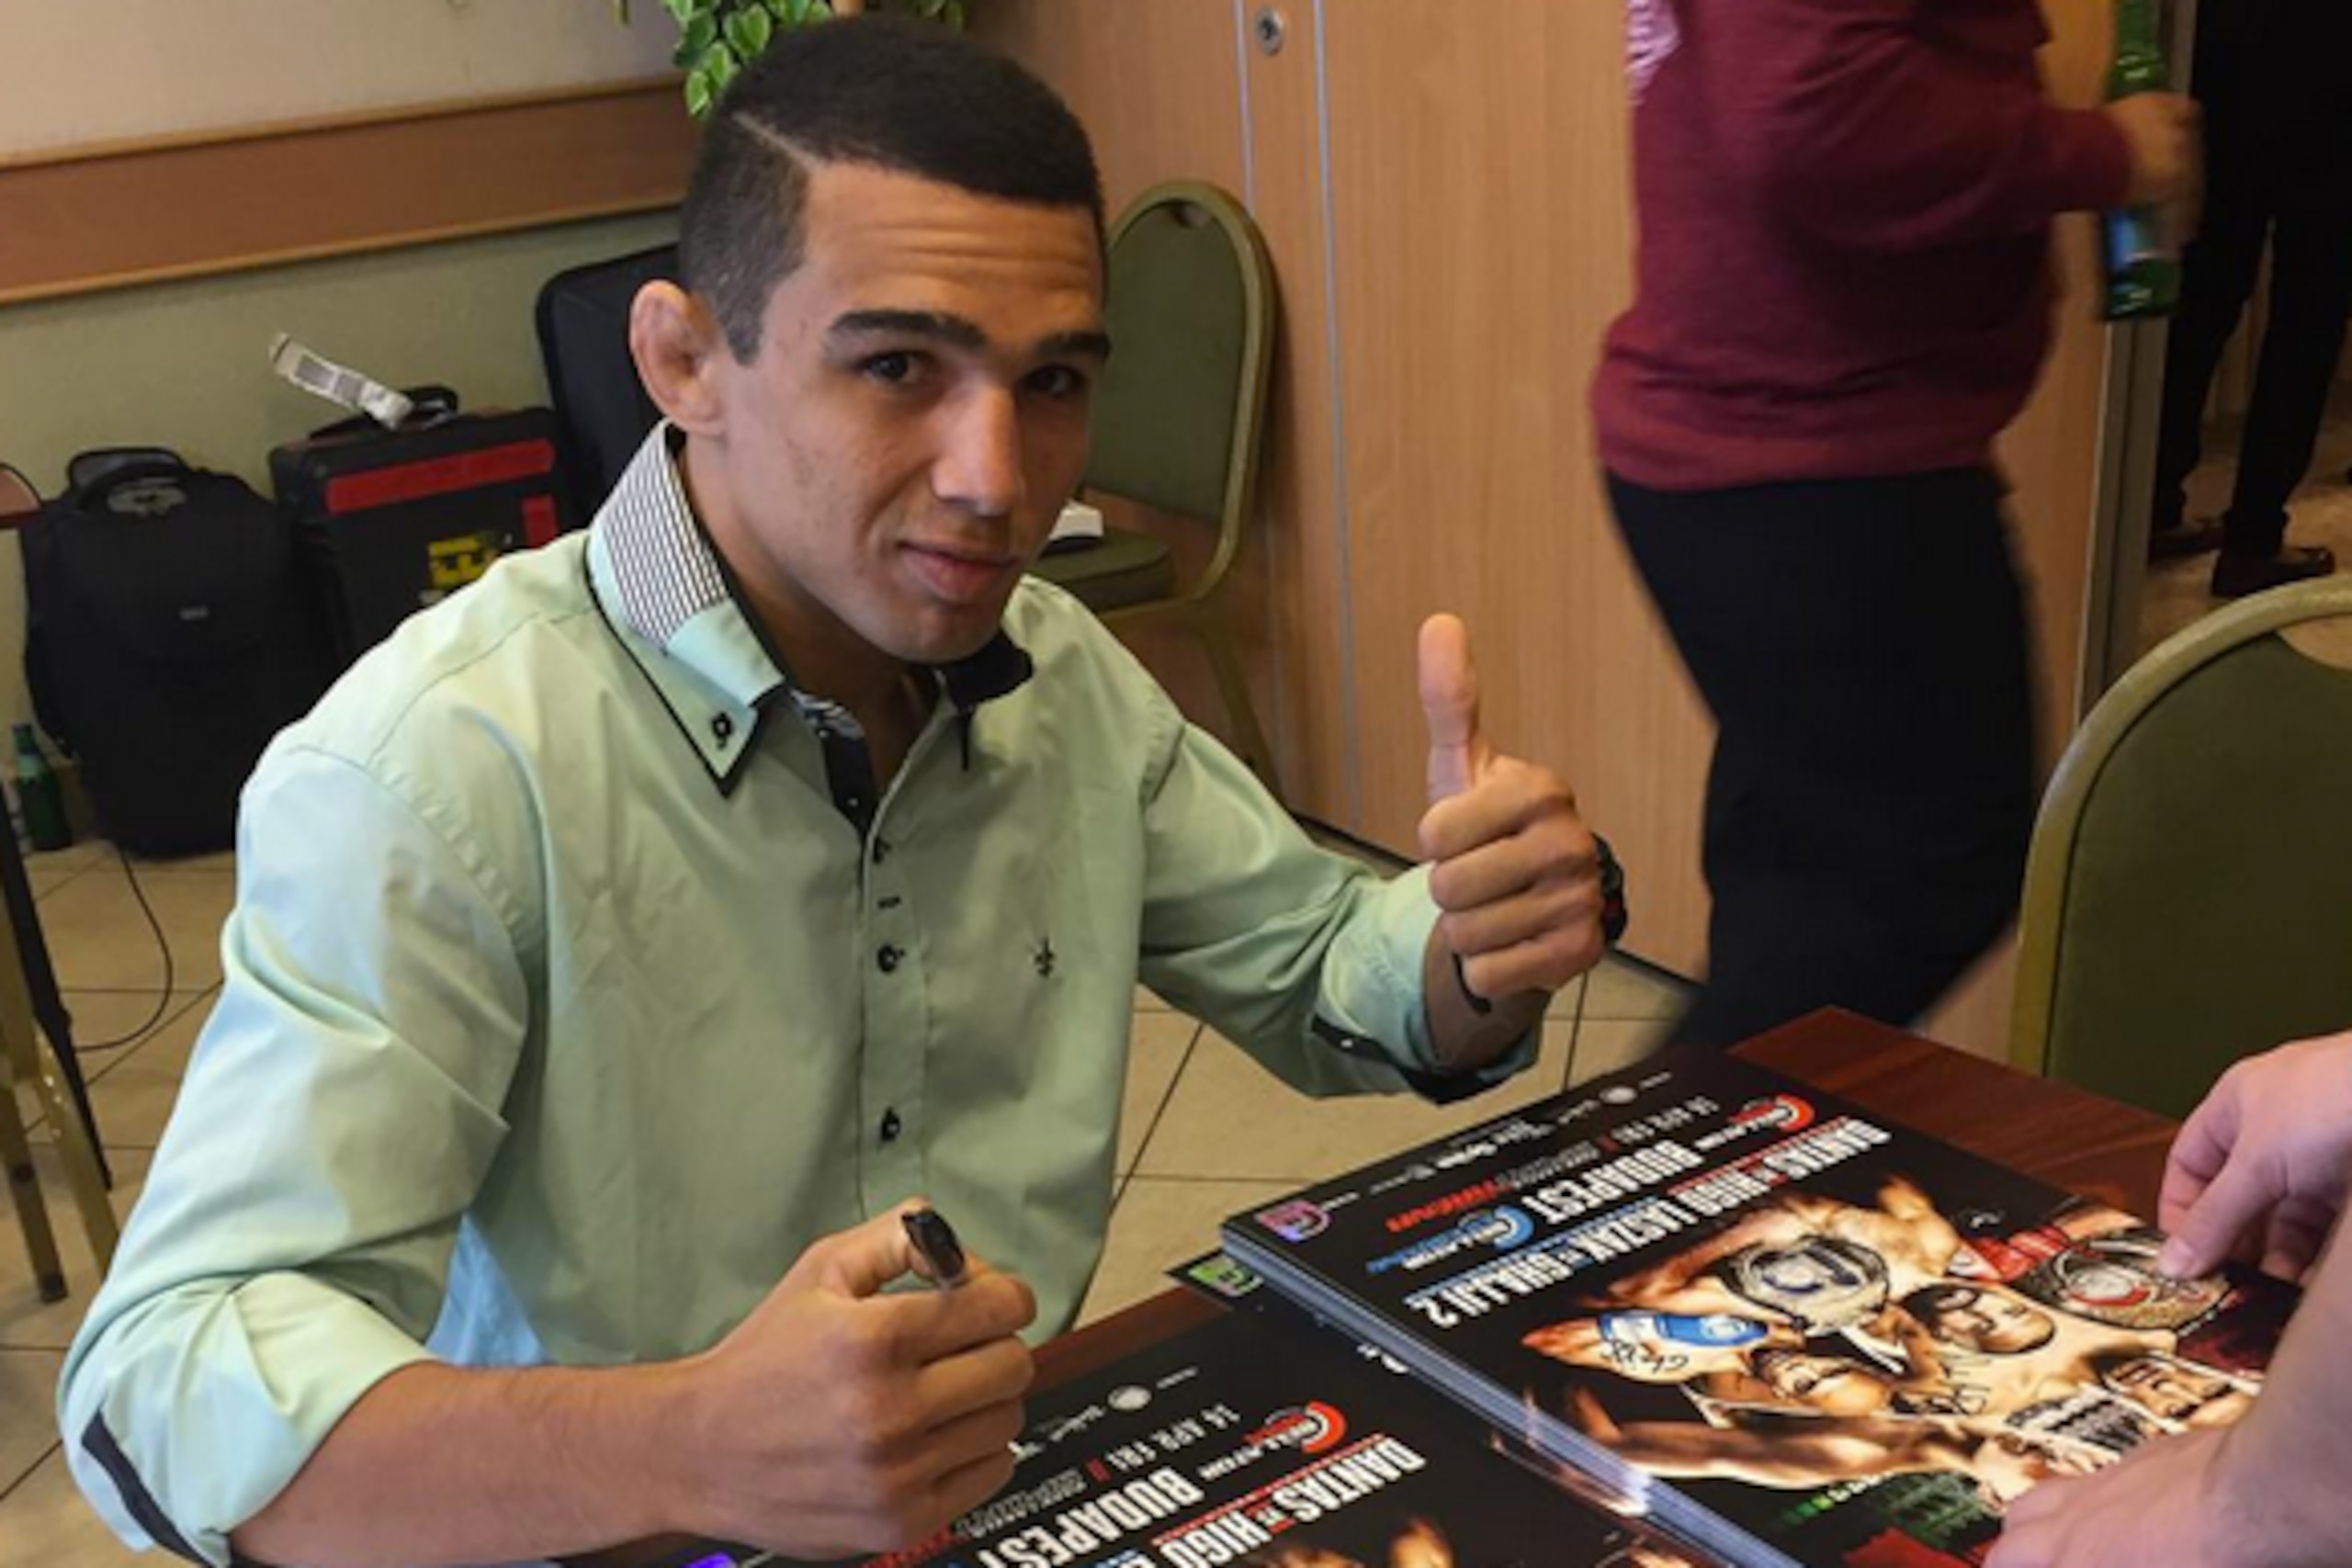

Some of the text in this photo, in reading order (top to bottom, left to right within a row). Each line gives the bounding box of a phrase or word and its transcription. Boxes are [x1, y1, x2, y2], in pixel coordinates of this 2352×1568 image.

[1763, 1120, 1892, 1181] DANTAS
[1521, 1140, 1704, 1225] BUDAPEST
[1674, 1168, 1770, 1217] HIGO
[1575, 1200, 1699, 1264] LASZAK
[1411, 1298, 1459, 1327] 2
[1441, 1253, 1571, 1318] GHAJJI
[1104, 1440, 1157, 1472] FRI
[1149, 1417, 1205, 1451] APR
[1272, 1437, 1426, 1521] DANTAS
[1159, 1510, 1272, 1568] HIGO
